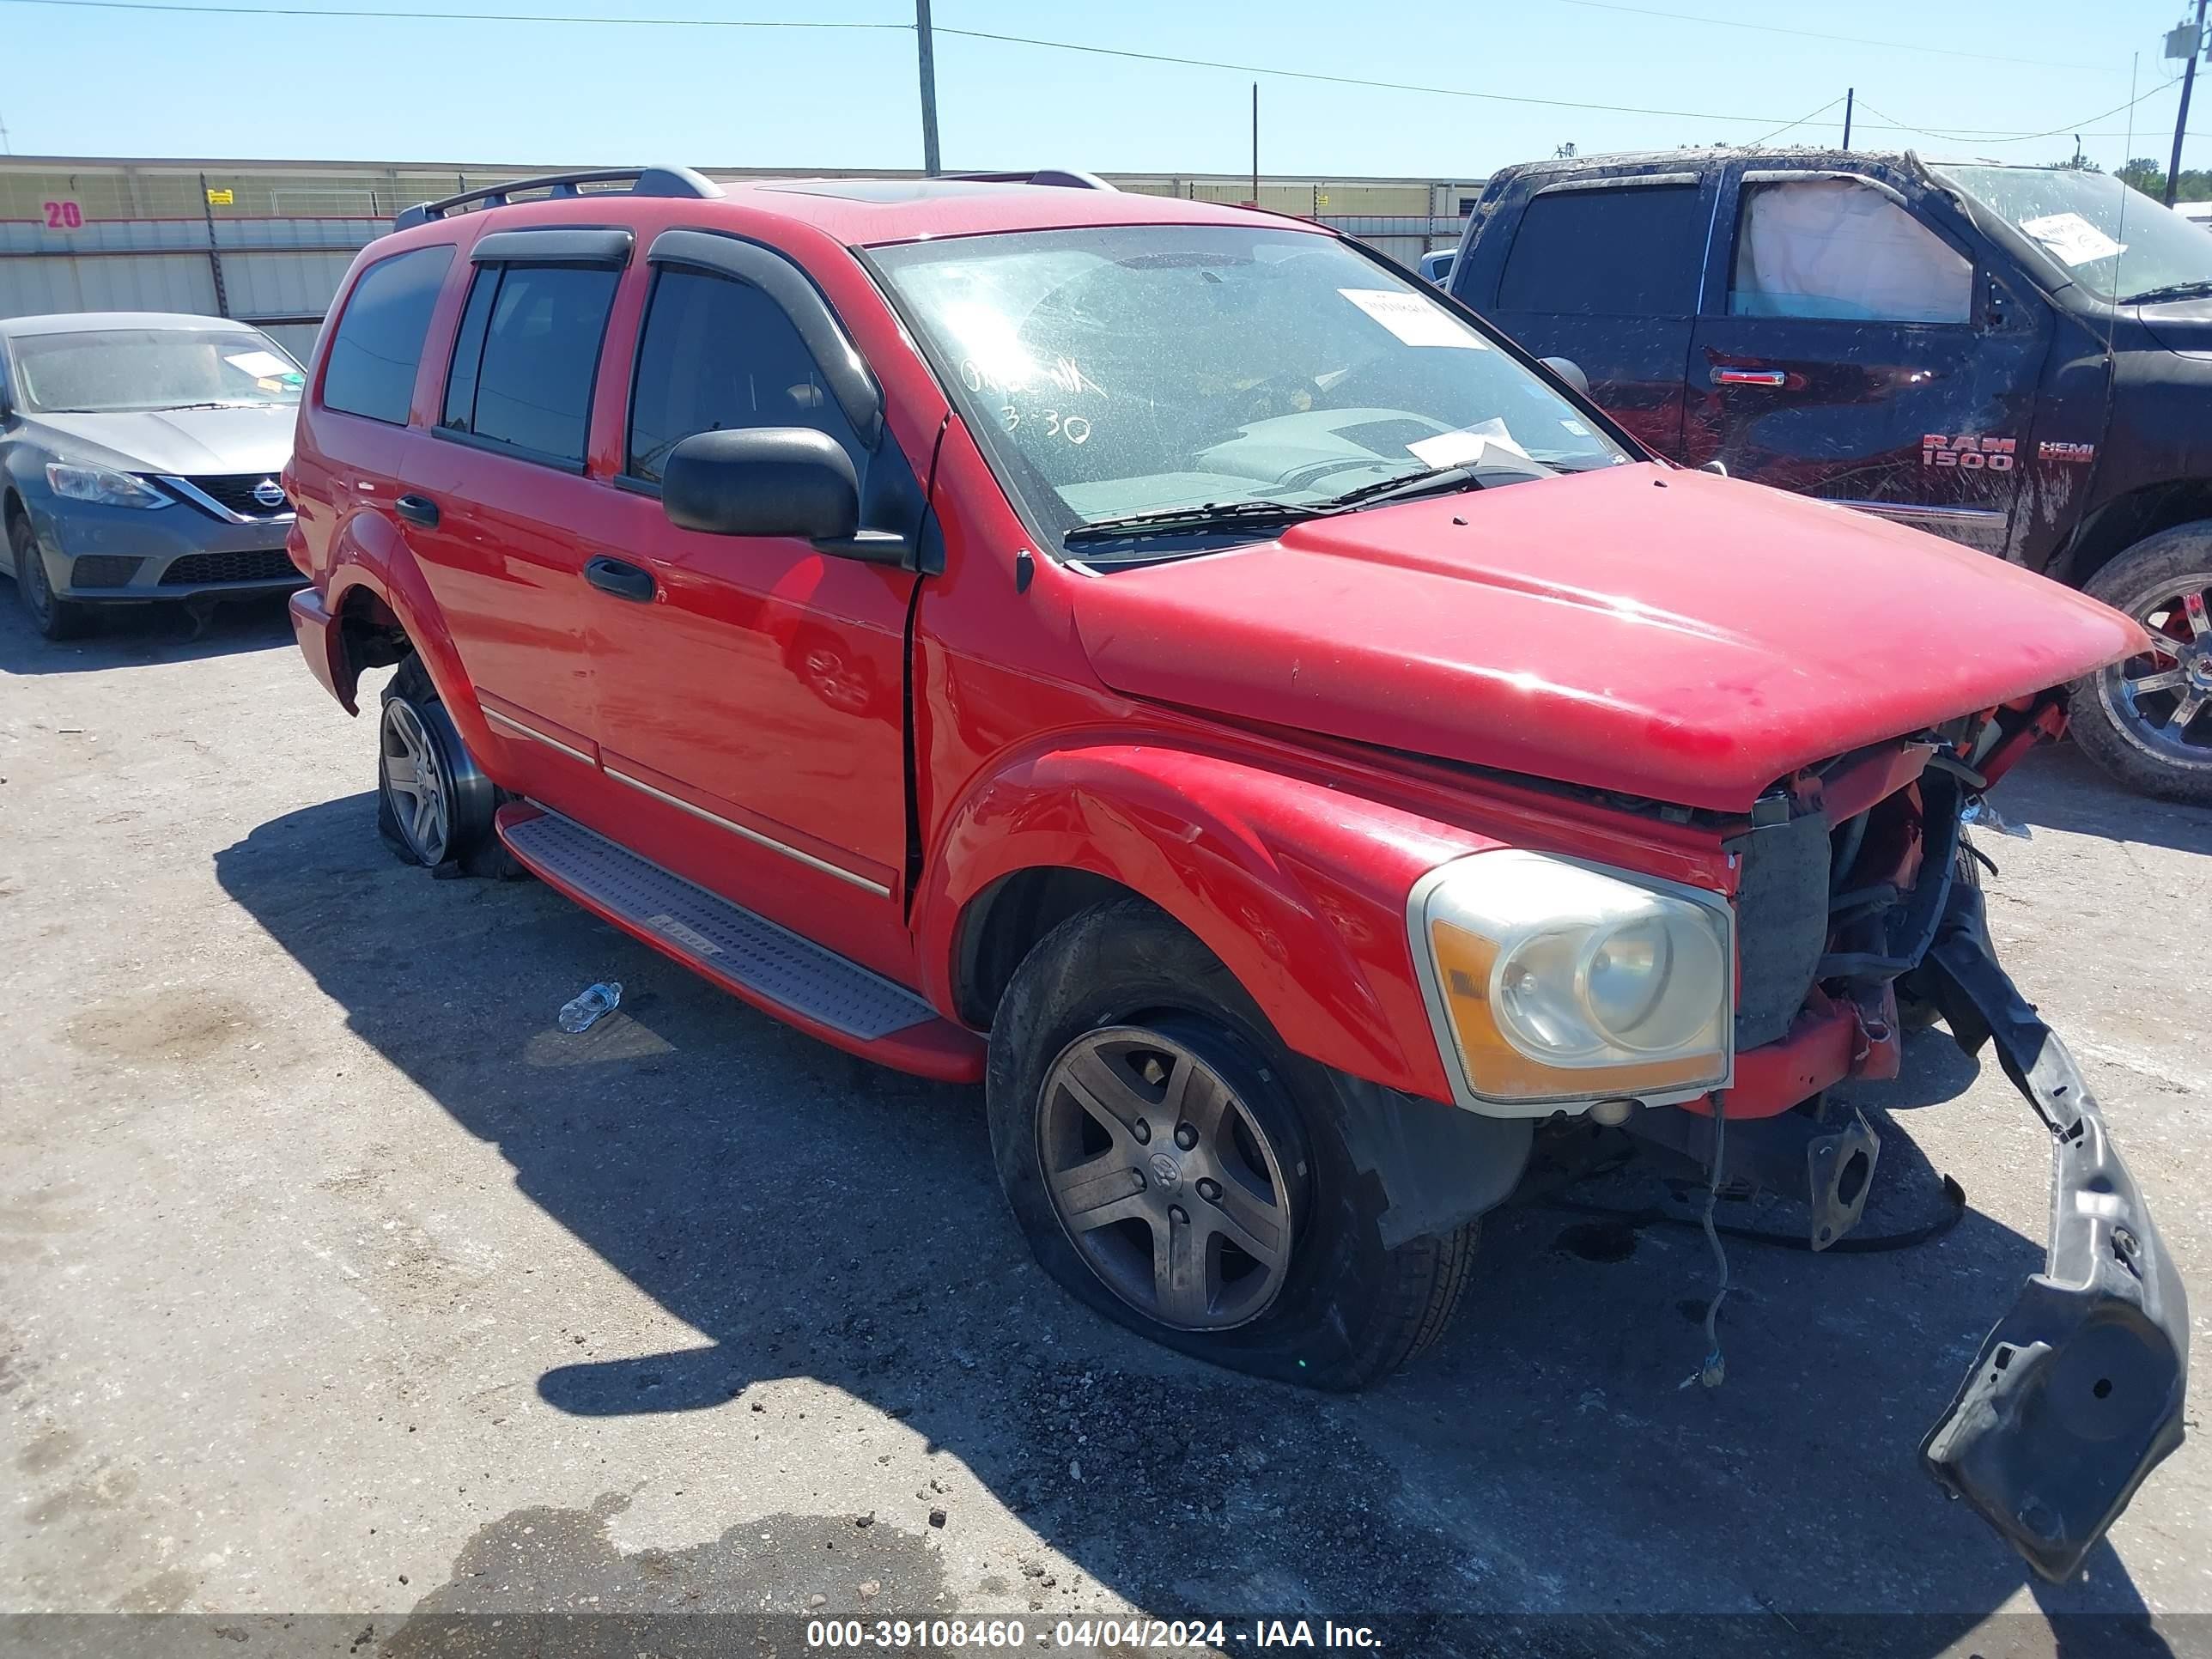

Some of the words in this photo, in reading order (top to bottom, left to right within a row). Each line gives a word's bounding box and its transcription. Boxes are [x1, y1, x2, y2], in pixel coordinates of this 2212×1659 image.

[44, 202, 82, 228] 20
[1923, 434, 2016, 453] RAM
[2039, 441, 2094, 454] HEMI
[1923, 450, 2014, 471] 1500
